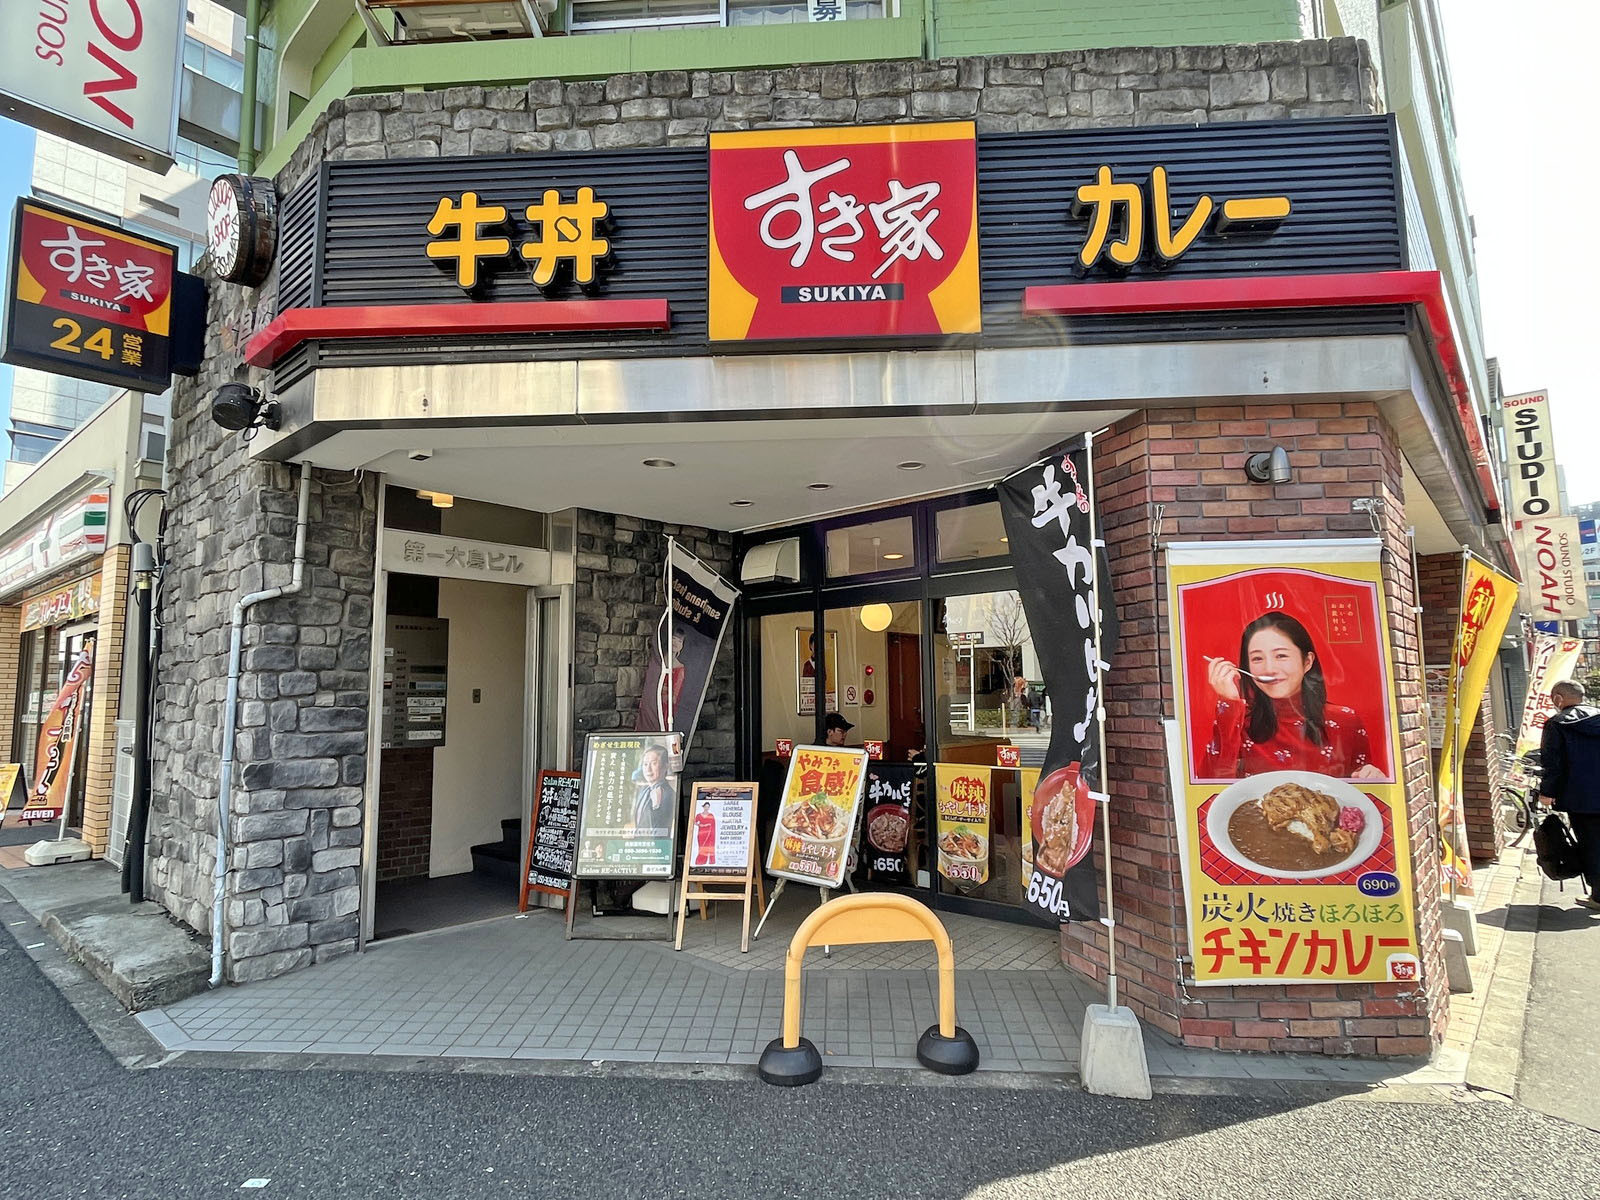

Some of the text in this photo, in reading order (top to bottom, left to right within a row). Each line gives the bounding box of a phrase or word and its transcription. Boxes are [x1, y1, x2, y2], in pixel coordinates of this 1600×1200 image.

[36, 0, 69, 66] SOU
[213, 214, 231, 248] SHOP
[426, 186, 609, 288] 牛丼
[744, 149, 944, 281] すき家
[1077, 165, 1291, 266] カレー
[41, 226, 154, 303] すき家
[70, 292, 122, 312] SUKIYA
[798, 286, 887, 302] SUKIYA
[51, 318, 143, 366] 24 営業
[1504, 395, 1545, 408] SOUND
[1515, 408, 1550, 515] STUDIO
[1534, 526, 1562, 614] NOAH
[1559, 533, 1576, 606] SOUND STUDIO
[798, 753, 841, 771] やみつき
[952, 780, 985, 803] 麻辣
[1362, 878, 1396, 891] 690円
[1202, 927, 1410, 975] チキンカレー
